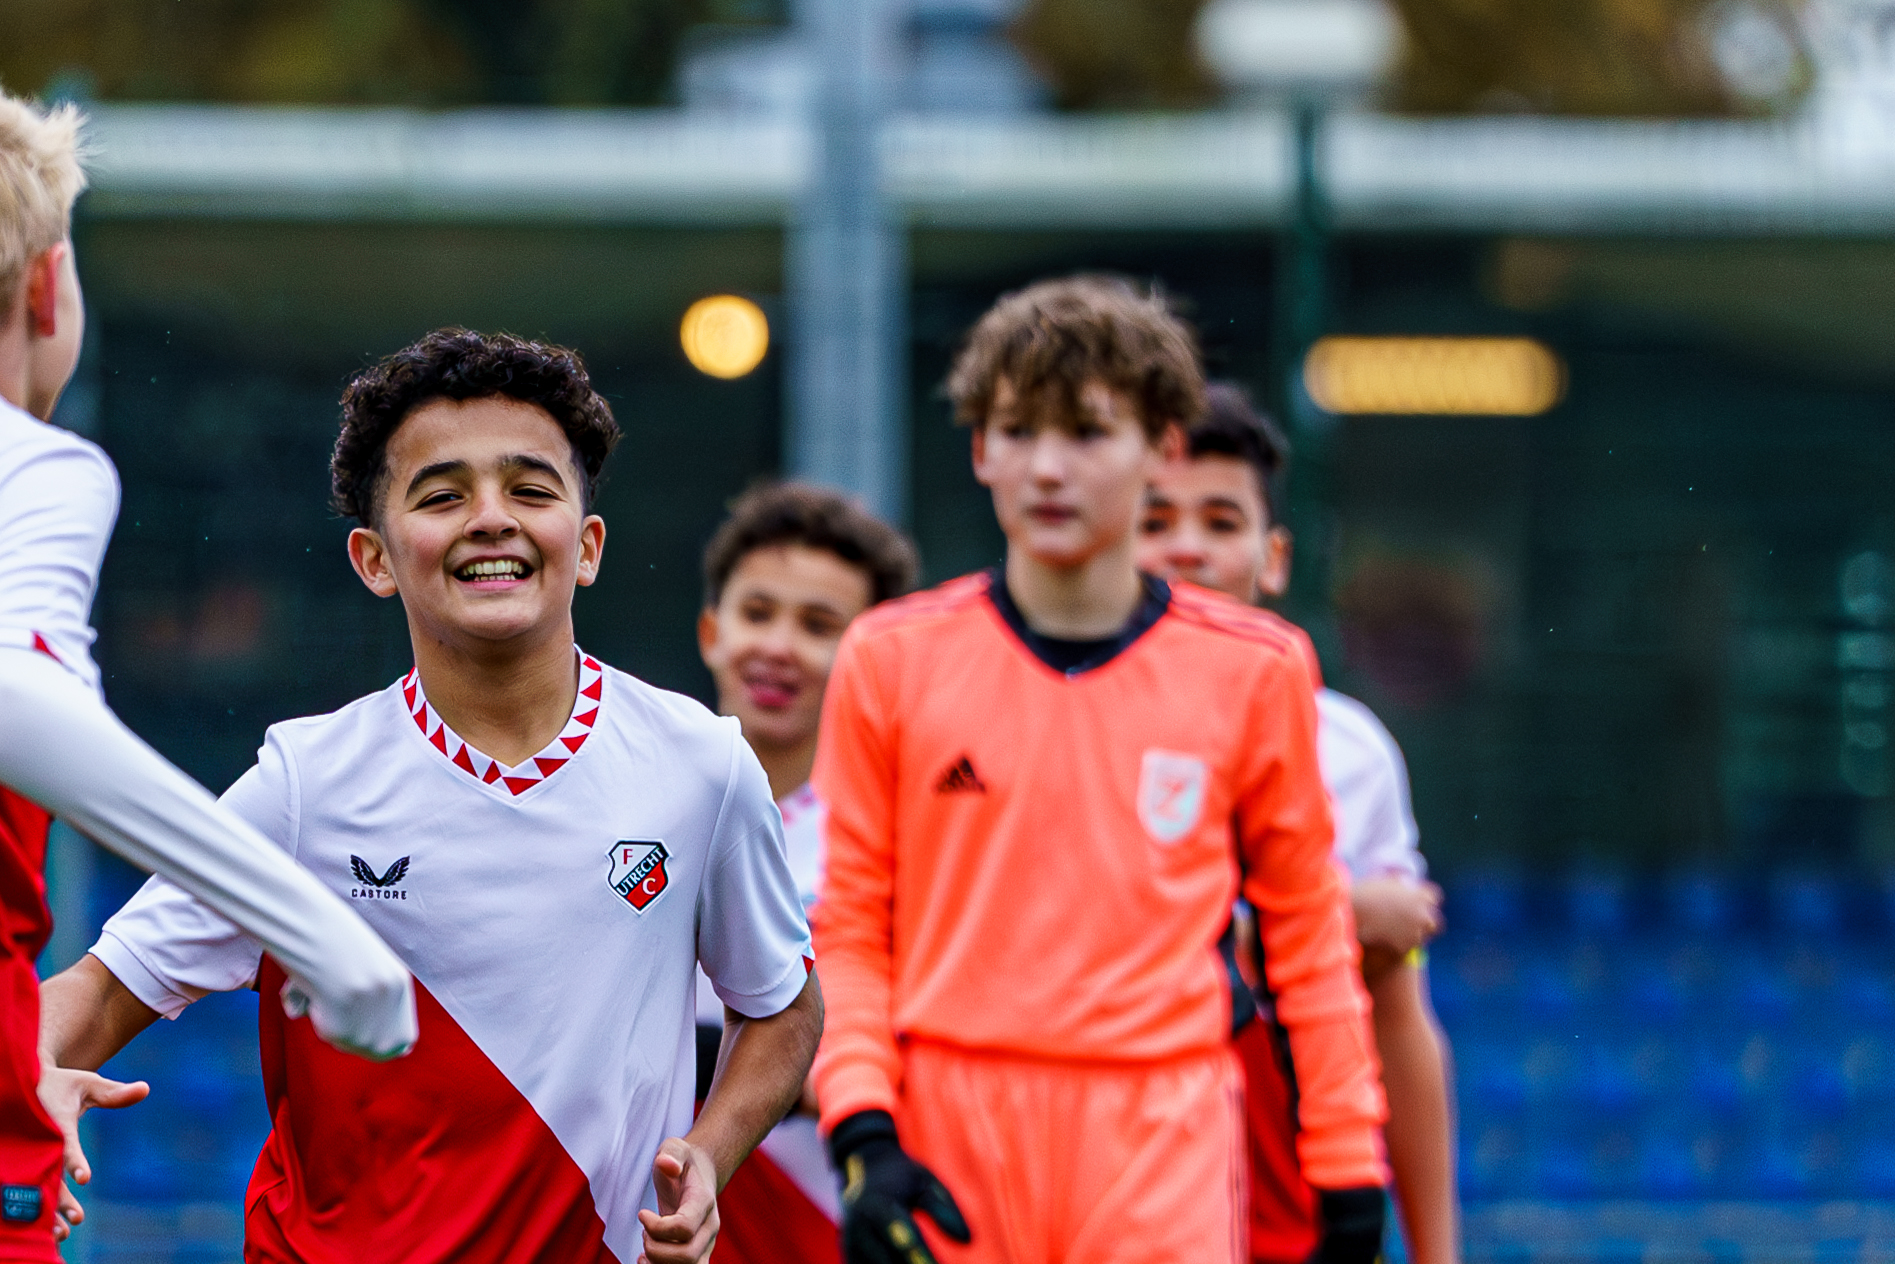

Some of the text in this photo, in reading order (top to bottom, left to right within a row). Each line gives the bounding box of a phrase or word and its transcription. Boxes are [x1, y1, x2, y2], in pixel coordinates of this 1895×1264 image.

[623, 848, 633, 865] F
[615, 847, 664, 896] UTRECHT
[350, 888, 407, 900] CASTORE
[642, 877, 656, 896] C
